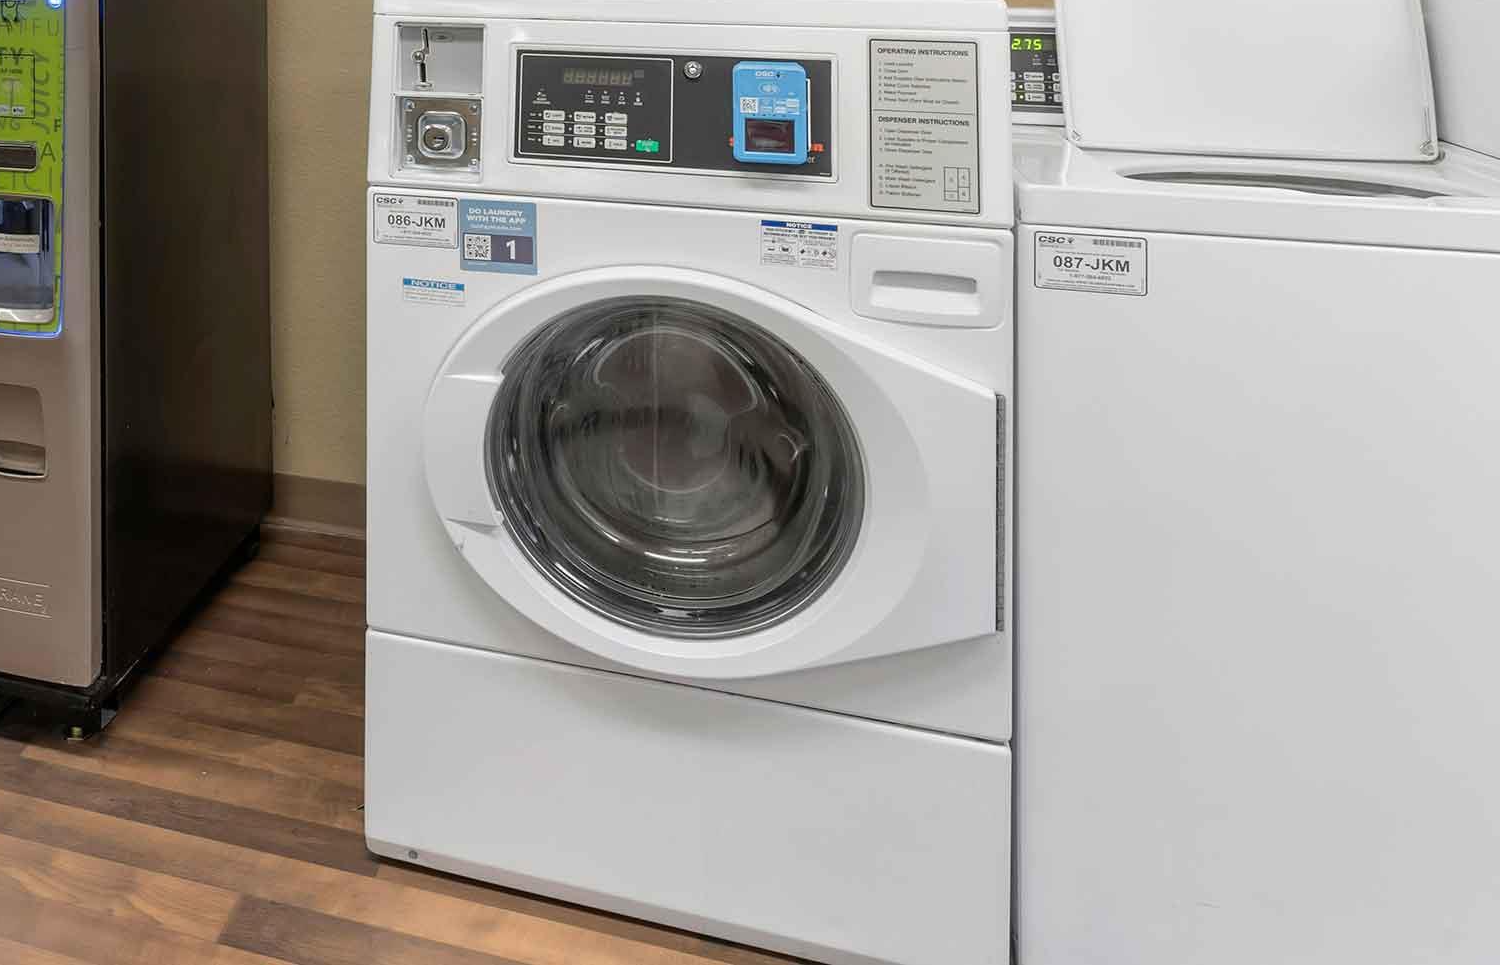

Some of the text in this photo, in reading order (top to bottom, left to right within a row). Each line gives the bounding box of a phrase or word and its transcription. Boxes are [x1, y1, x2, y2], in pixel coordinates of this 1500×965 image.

[1011, 39, 1043, 50] 2.75
[919, 117, 970, 126] INSTRUCTIONS
[468, 207, 524, 217] DO LAUNDRY
[388, 214, 446, 228] 086-JKM
[466, 214, 491, 222] WITH
[1038, 235, 1066, 244] CSC
[506, 239, 517, 260] 1
[1053, 255, 1130, 273] 087-JKM
[410, 279, 458, 290] NOTICE
